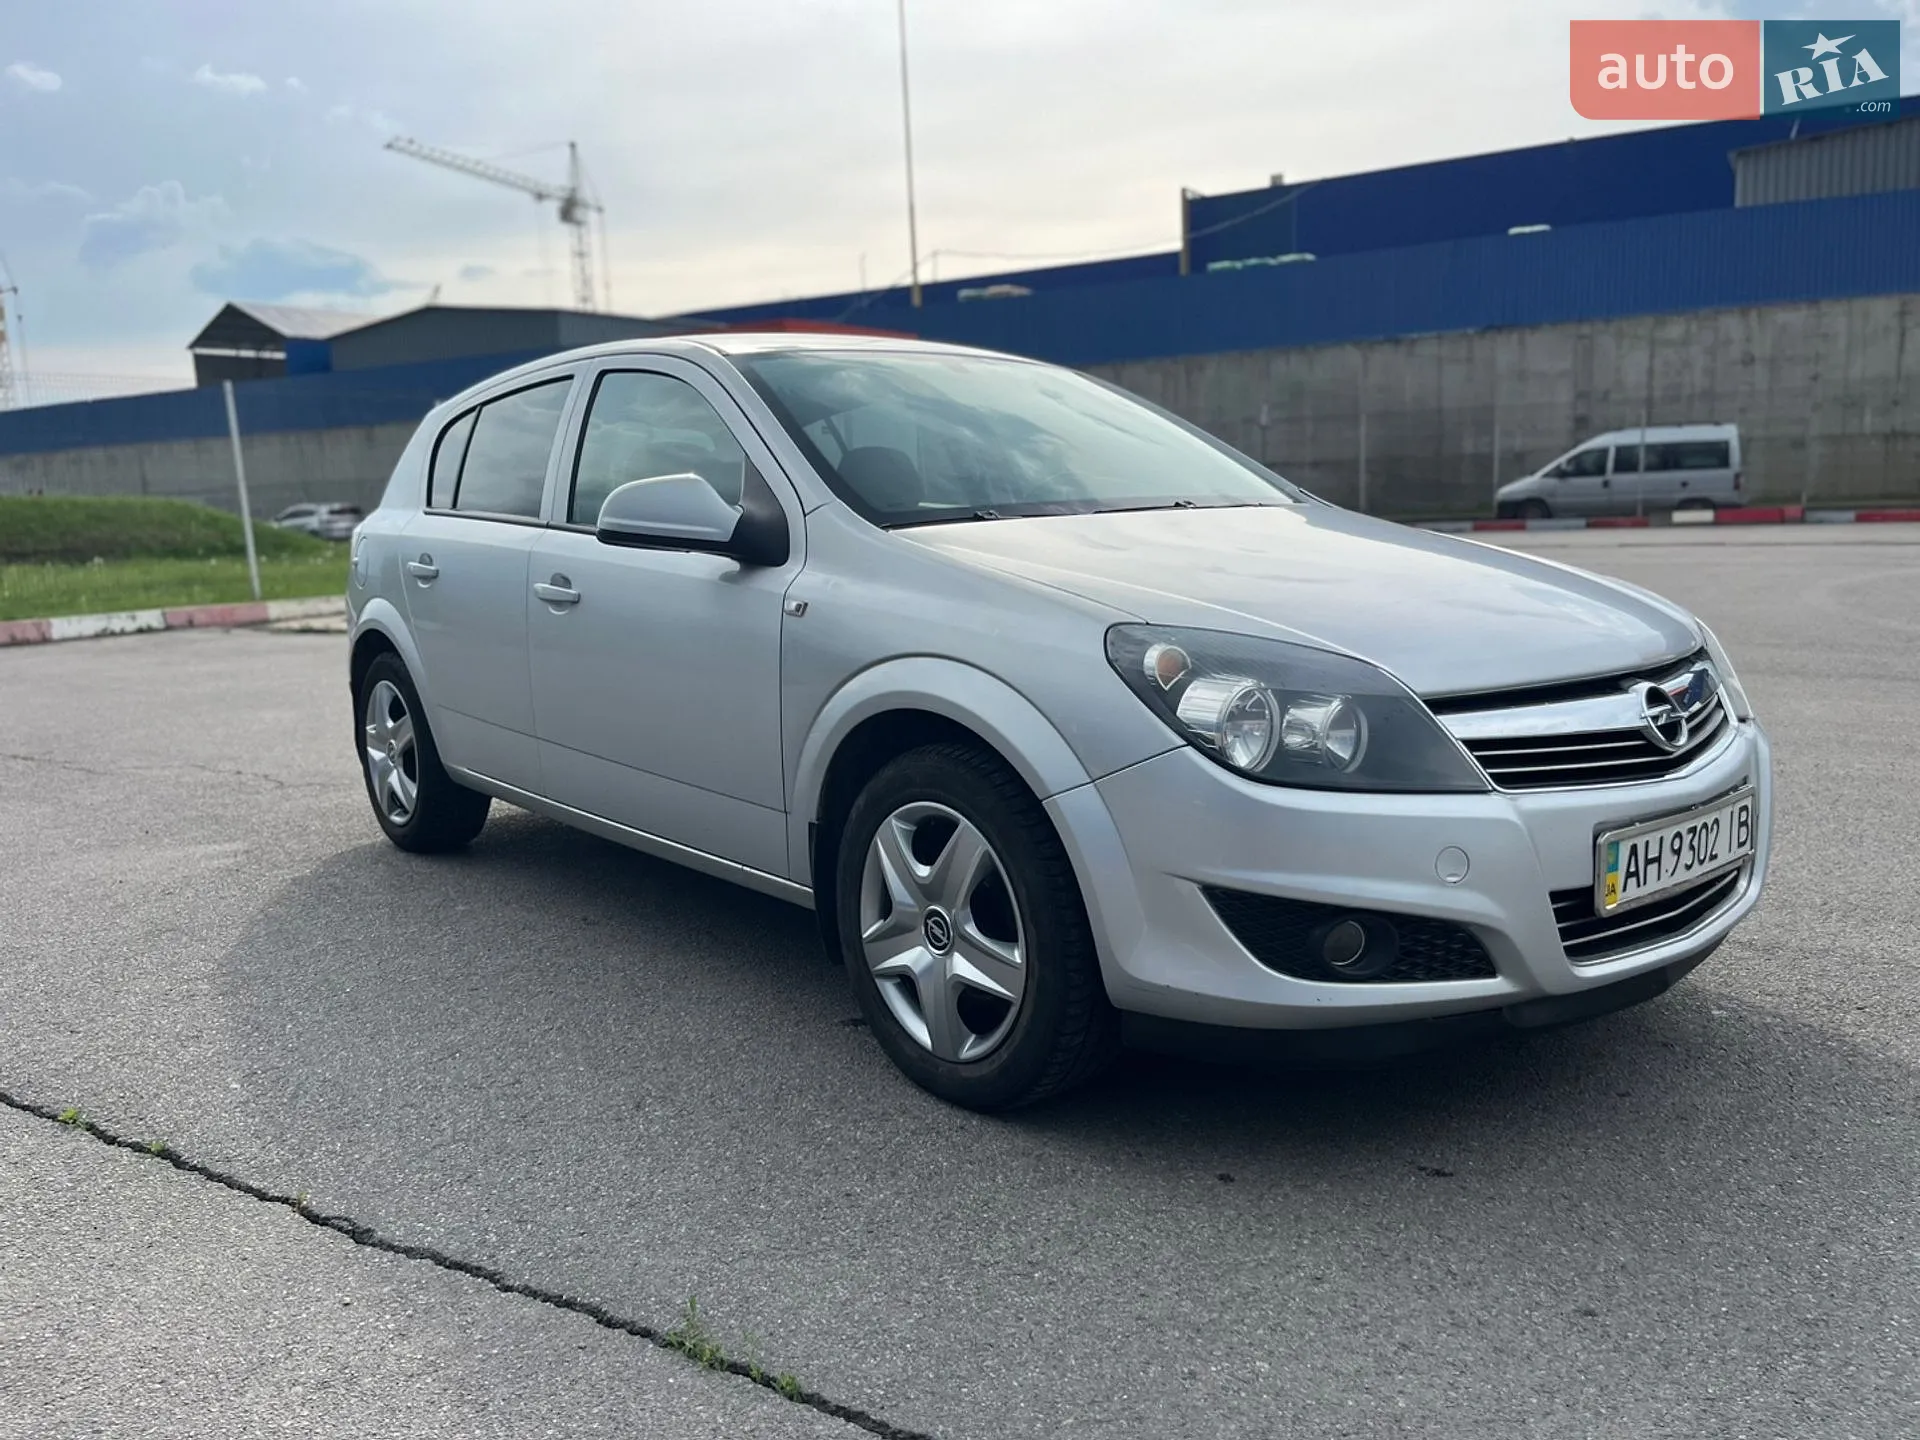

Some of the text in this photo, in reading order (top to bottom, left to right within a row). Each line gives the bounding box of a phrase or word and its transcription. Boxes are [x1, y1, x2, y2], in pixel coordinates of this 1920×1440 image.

[1622, 804, 1750, 893] AH 9302 IB
